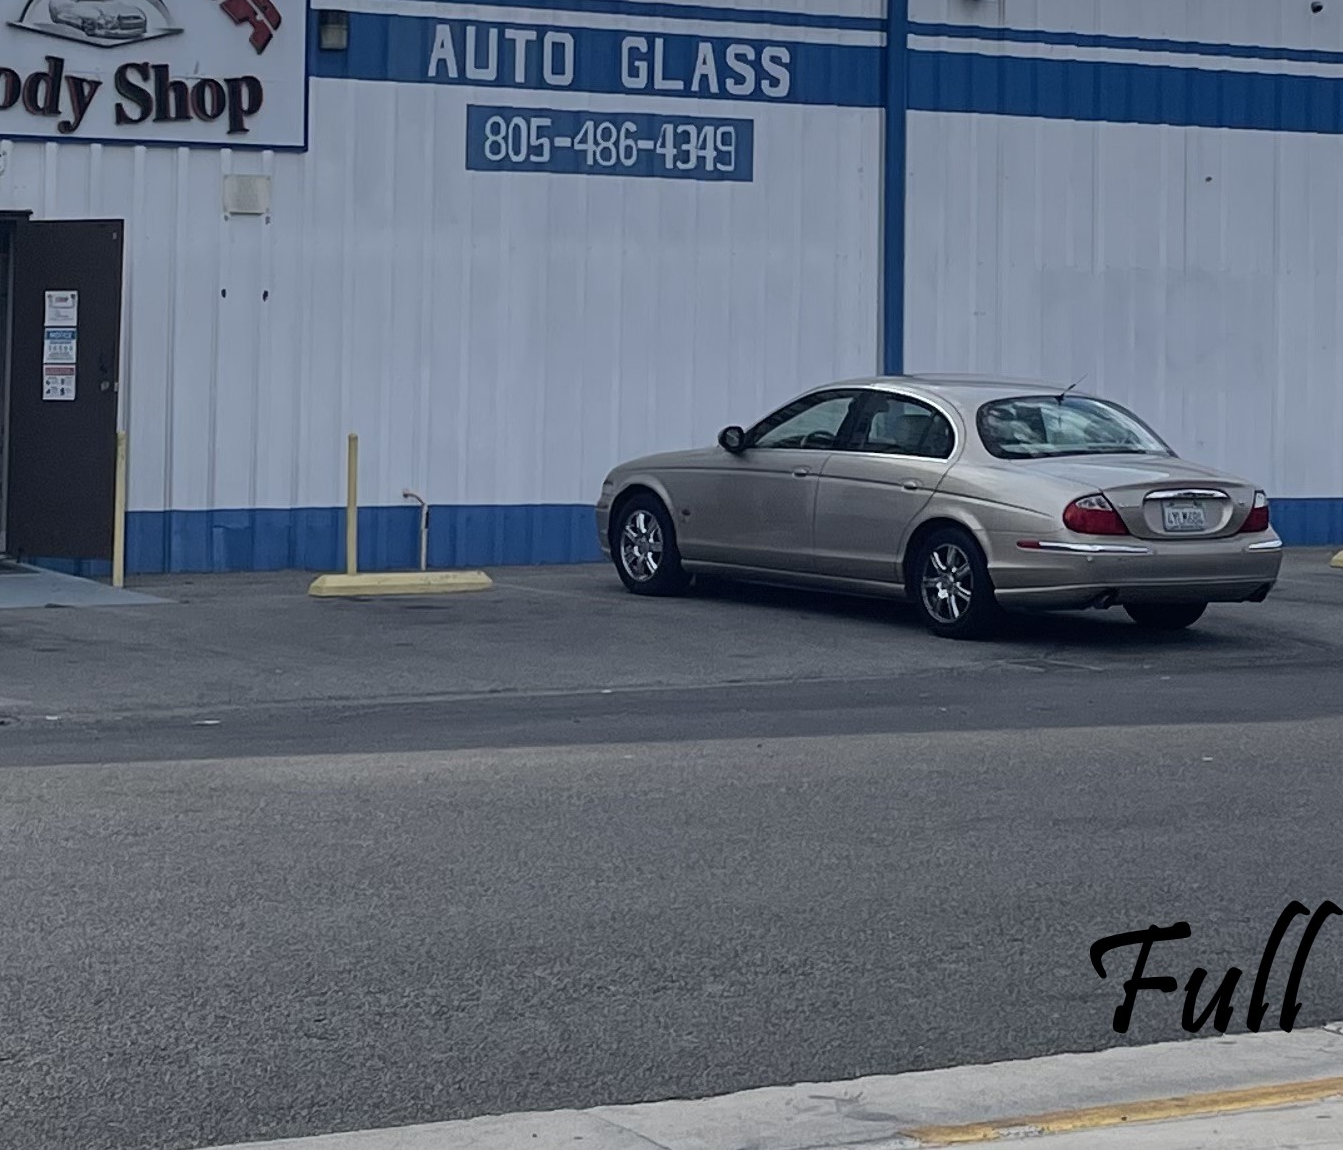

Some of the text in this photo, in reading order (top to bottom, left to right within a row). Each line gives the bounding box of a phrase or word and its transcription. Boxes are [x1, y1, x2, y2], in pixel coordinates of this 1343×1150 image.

[427, 23, 792, 98] AUTO GLASS
[114, 61, 264, 135] Shop
[483, 114, 736, 172] 805-486-4349
